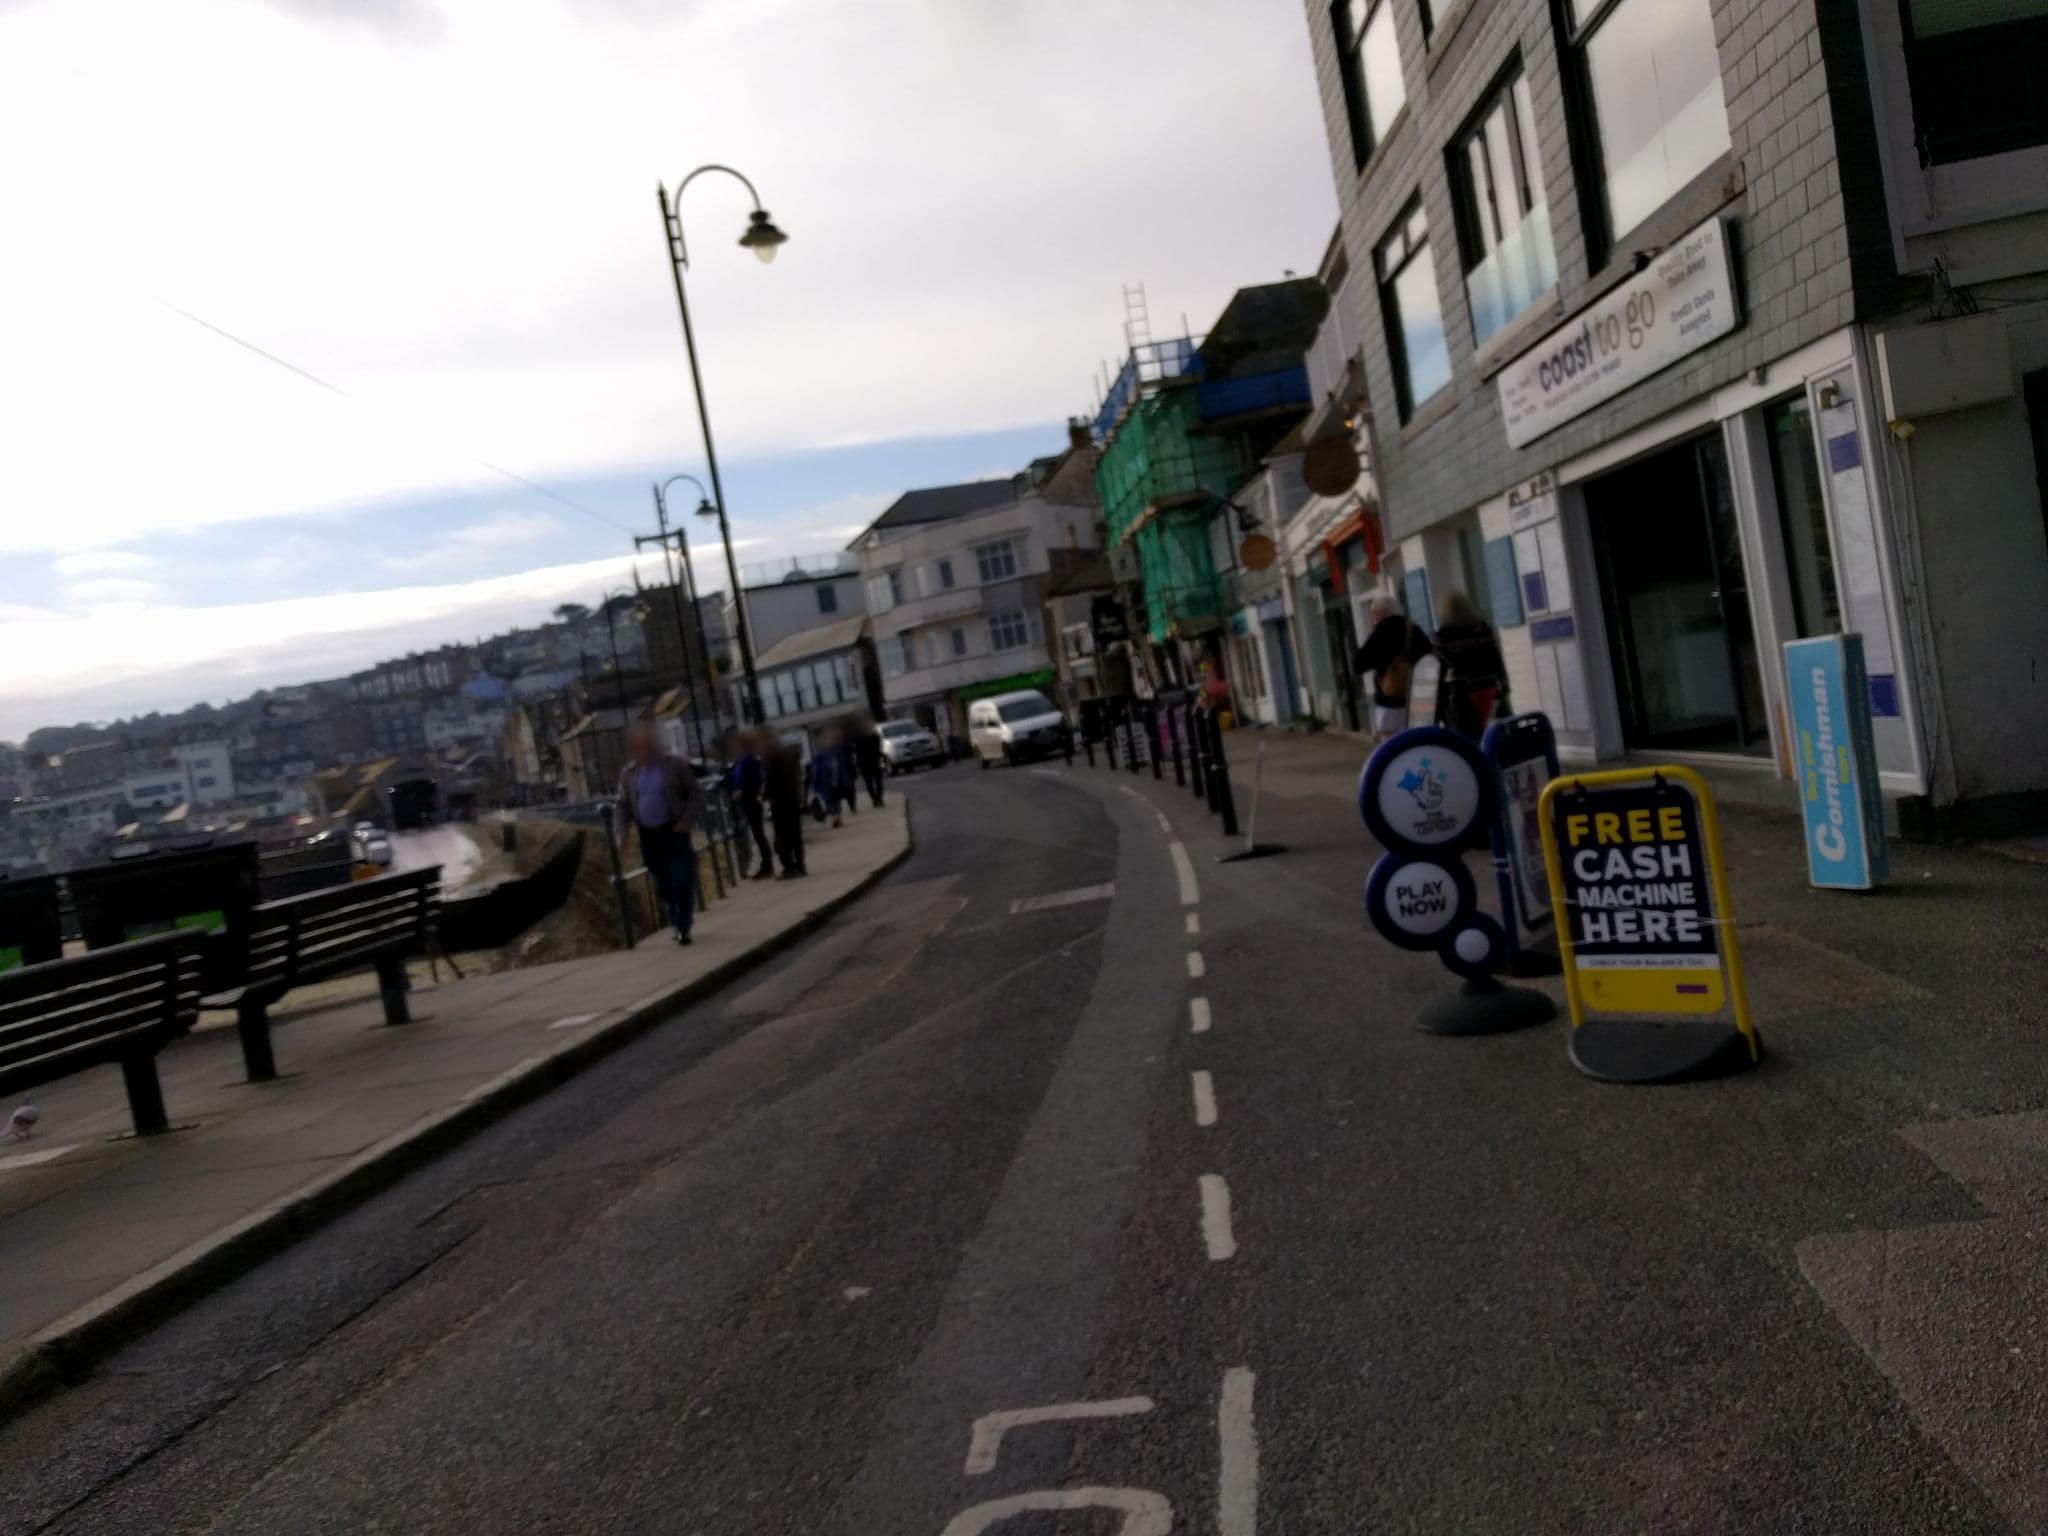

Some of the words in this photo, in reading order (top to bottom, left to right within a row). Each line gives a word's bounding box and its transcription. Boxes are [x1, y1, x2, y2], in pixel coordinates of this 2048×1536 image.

[1539, 321, 1594, 393] coast
[1594, 313, 1621, 357] to
[1626, 289, 1655, 350] go
[1812, 667, 1846, 862] Cornishman
[1567, 806, 1686, 847] FREE
[1573, 844, 1692, 882] CASH
[1396, 880, 1443, 900] PLAY
[1399, 896, 1447, 918] NOW
[1577, 882, 1696, 907] MACHINE
[1581, 909, 1702, 943] HERE
